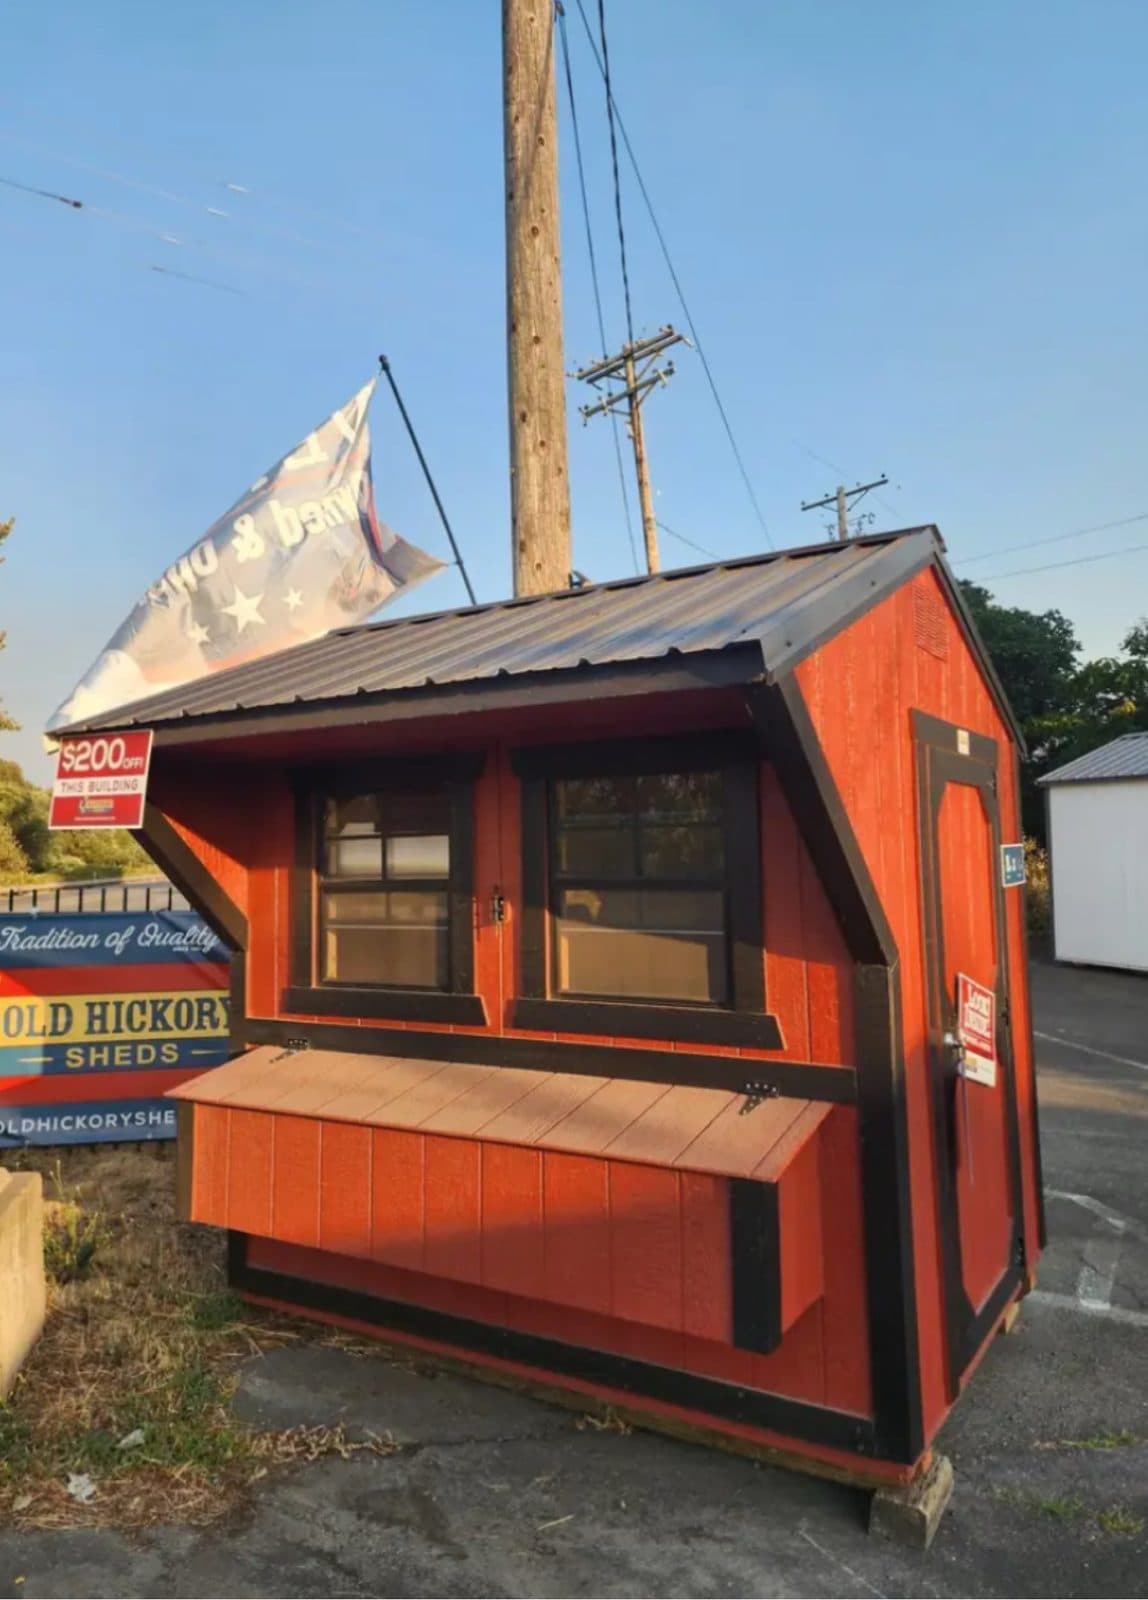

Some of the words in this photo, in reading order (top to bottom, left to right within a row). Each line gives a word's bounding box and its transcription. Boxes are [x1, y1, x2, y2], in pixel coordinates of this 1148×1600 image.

[62, 738, 126, 772] $200
[61, 781, 84, 793] THIS
[87, 778, 138, 793] BUILDING
[0, 926, 100, 951] Tradition
[104, 925, 135, 955] of
[137, 922, 220, 953] Quality
[3, 1002, 74, 1038] OLD
[65, 1043, 180, 1069] SHEDS
